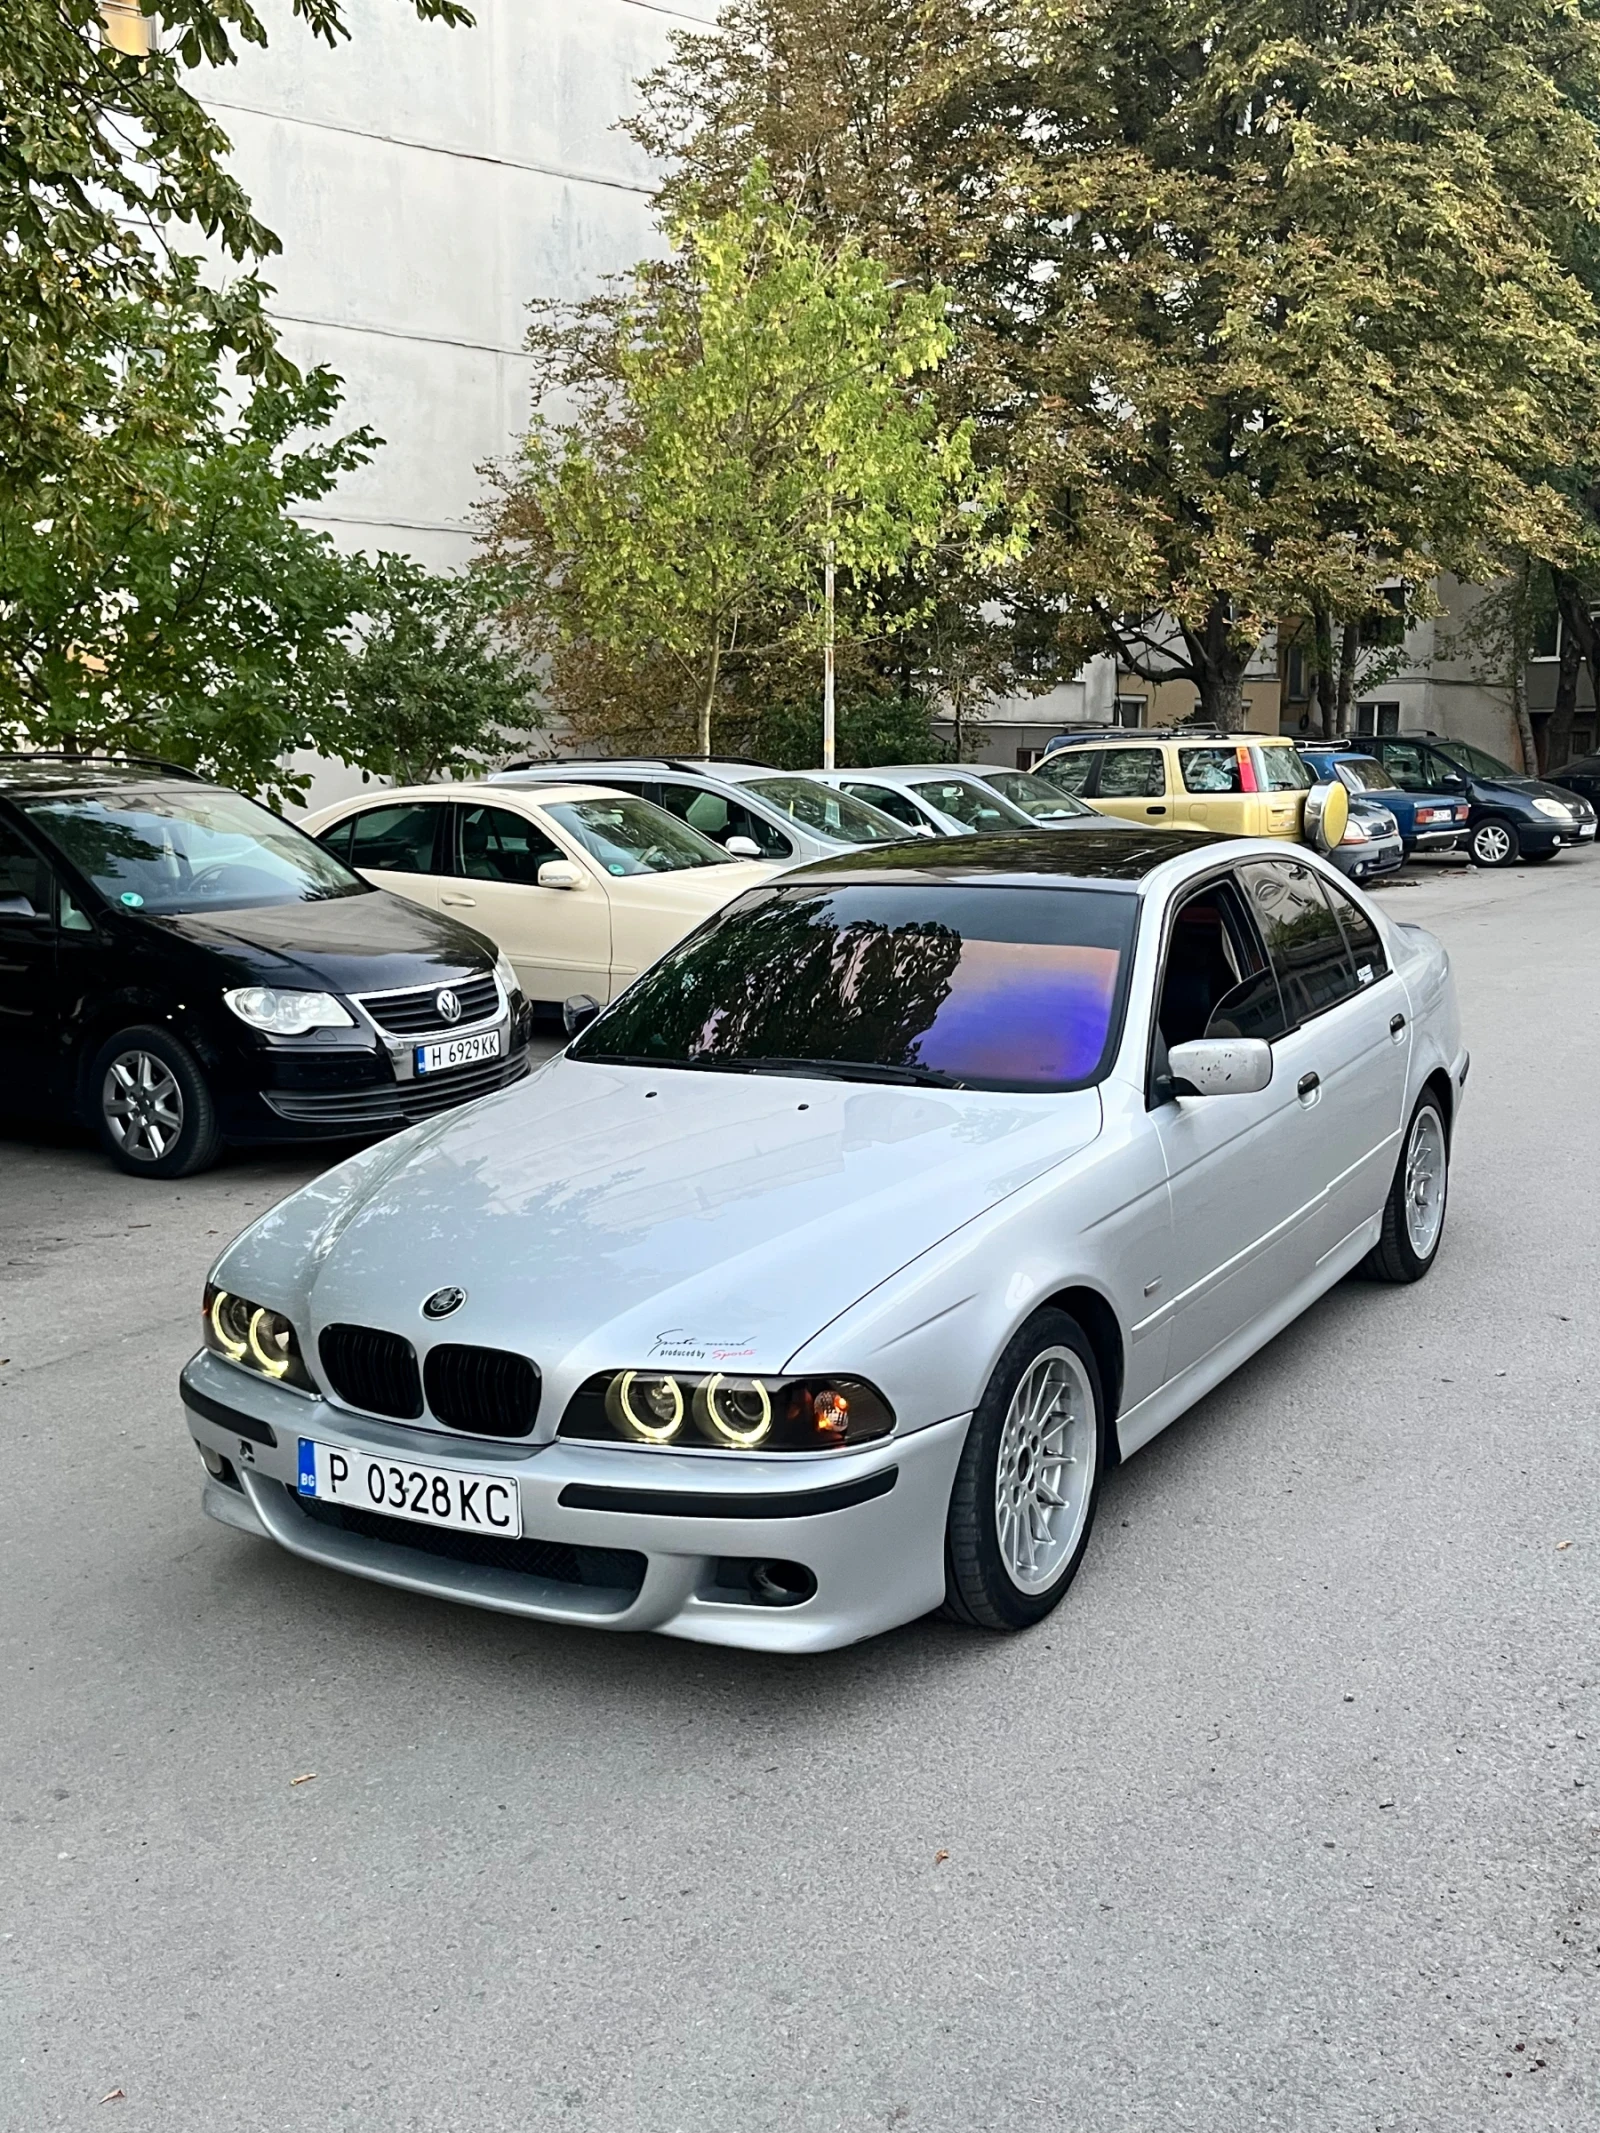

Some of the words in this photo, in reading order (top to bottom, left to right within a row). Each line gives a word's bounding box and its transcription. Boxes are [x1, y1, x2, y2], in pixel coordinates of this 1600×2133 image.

[660, 1349, 696, 1357] produced
[696, 1350, 705, 1359] by
[301, 1473, 315, 1487] BG
[329, 1453, 349, 1494] P
